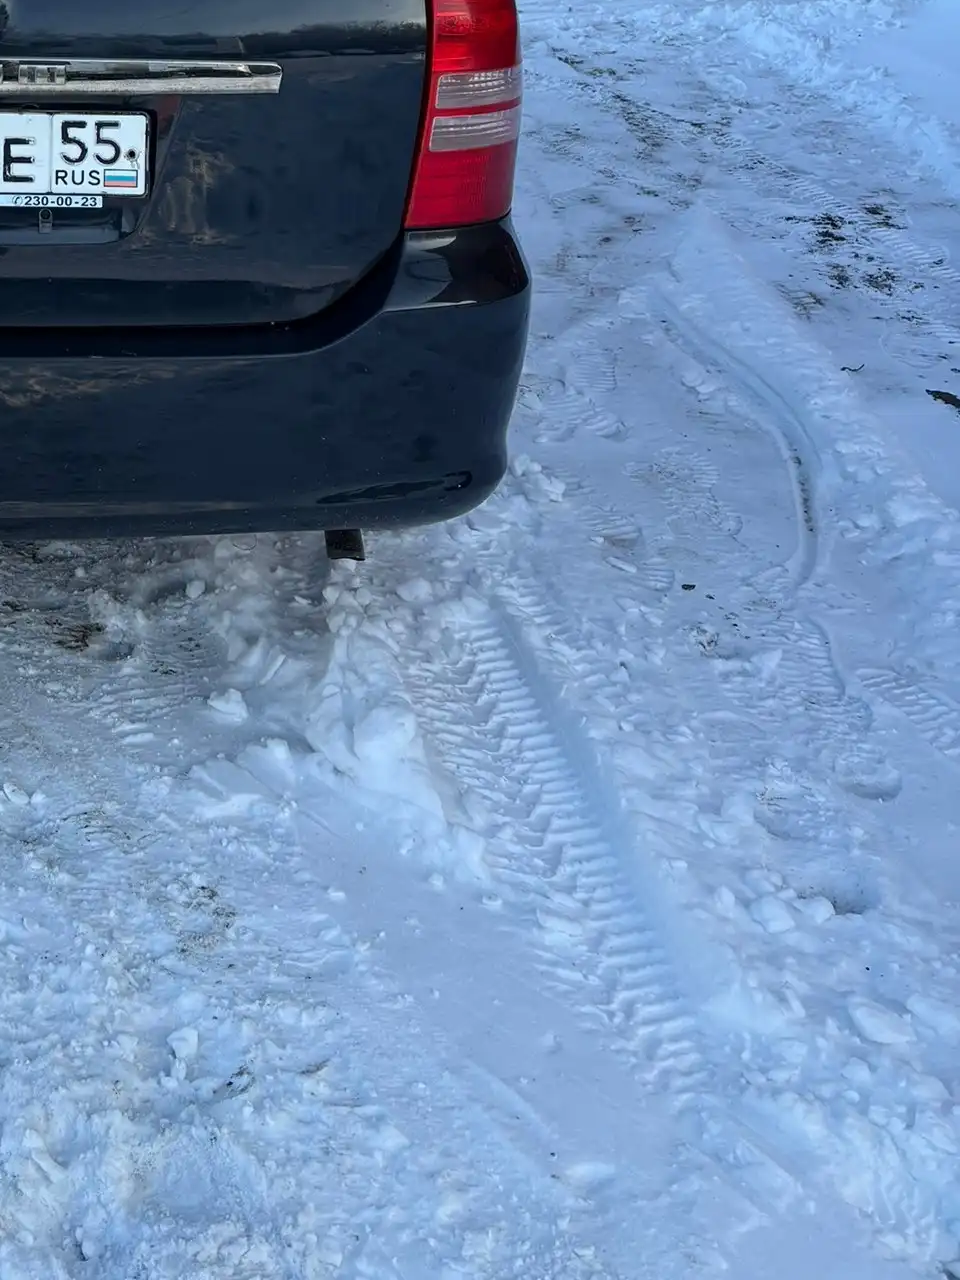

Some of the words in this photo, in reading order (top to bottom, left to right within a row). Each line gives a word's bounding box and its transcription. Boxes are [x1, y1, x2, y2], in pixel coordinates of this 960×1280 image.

[60, 120, 121, 165] 55
[55, 169, 101, 186] RUS
[24, 196, 98, 207] 230-00-23
